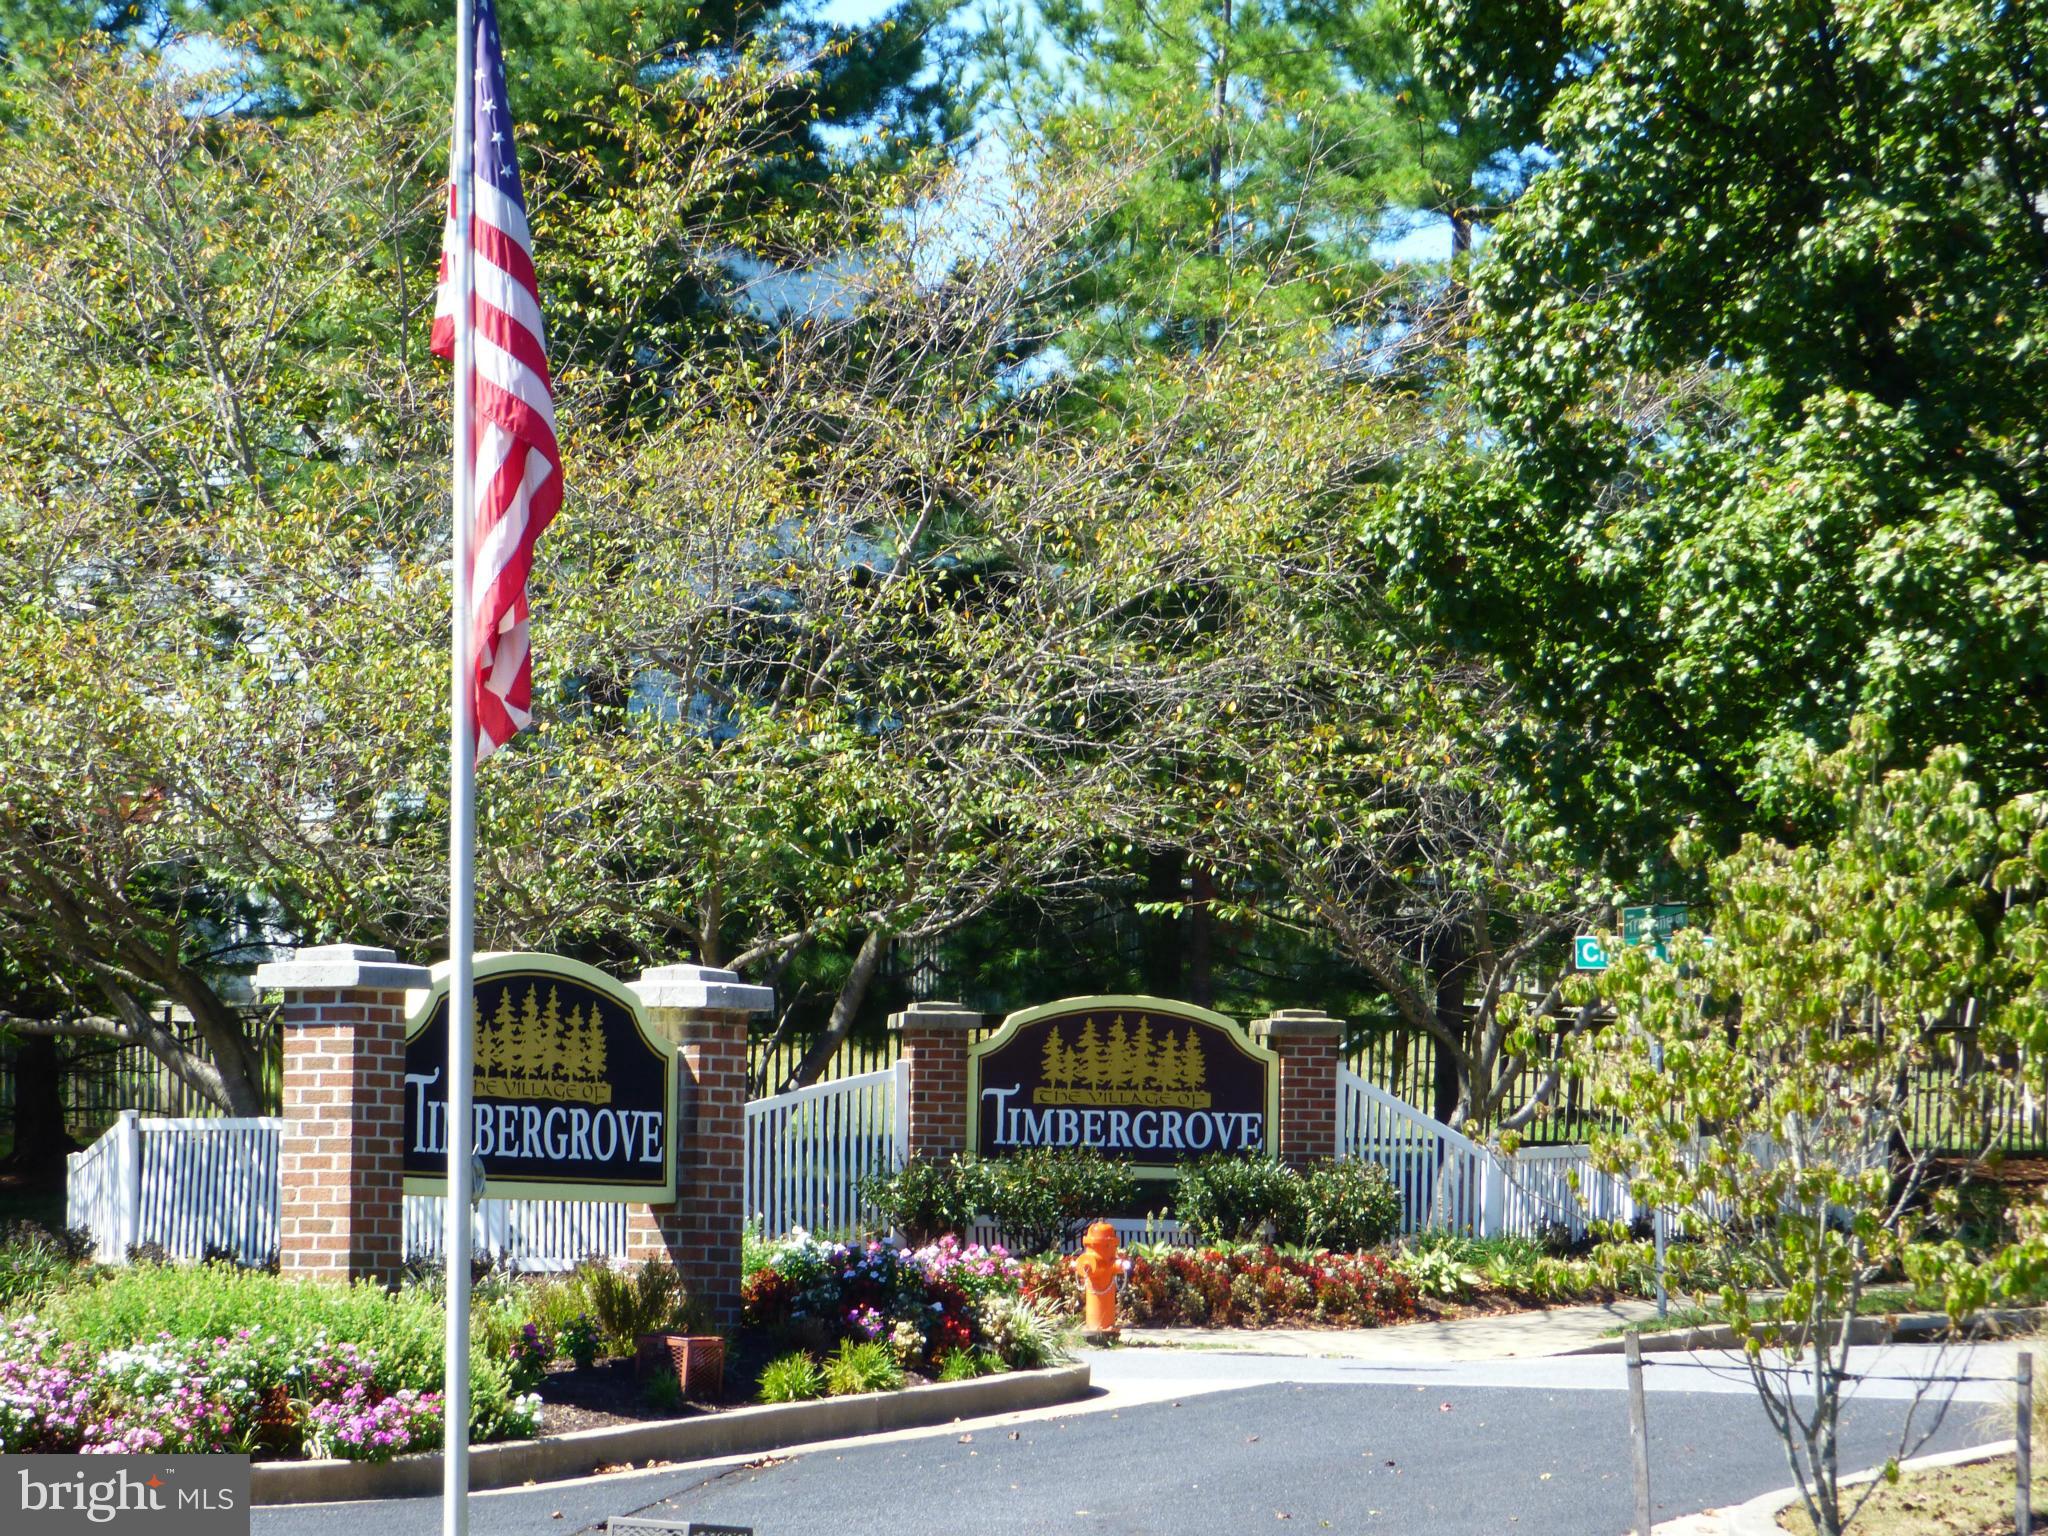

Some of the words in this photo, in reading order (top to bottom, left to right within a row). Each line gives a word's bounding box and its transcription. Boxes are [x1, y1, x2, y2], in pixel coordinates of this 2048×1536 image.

[404, 1065, 664, 1164] TIBERGROVE
[473, 1079, 498, 1095] HE
[503, 1080, 577, 1100] VILLAGE
[582, 1084, 608, 1104] OF
[1087, 1090, 1171, 1106] VILLAGE
[1177, 1092, 1206, 1109] OF
[981, 1082, 1264, 1151] TIMBERGROVE
